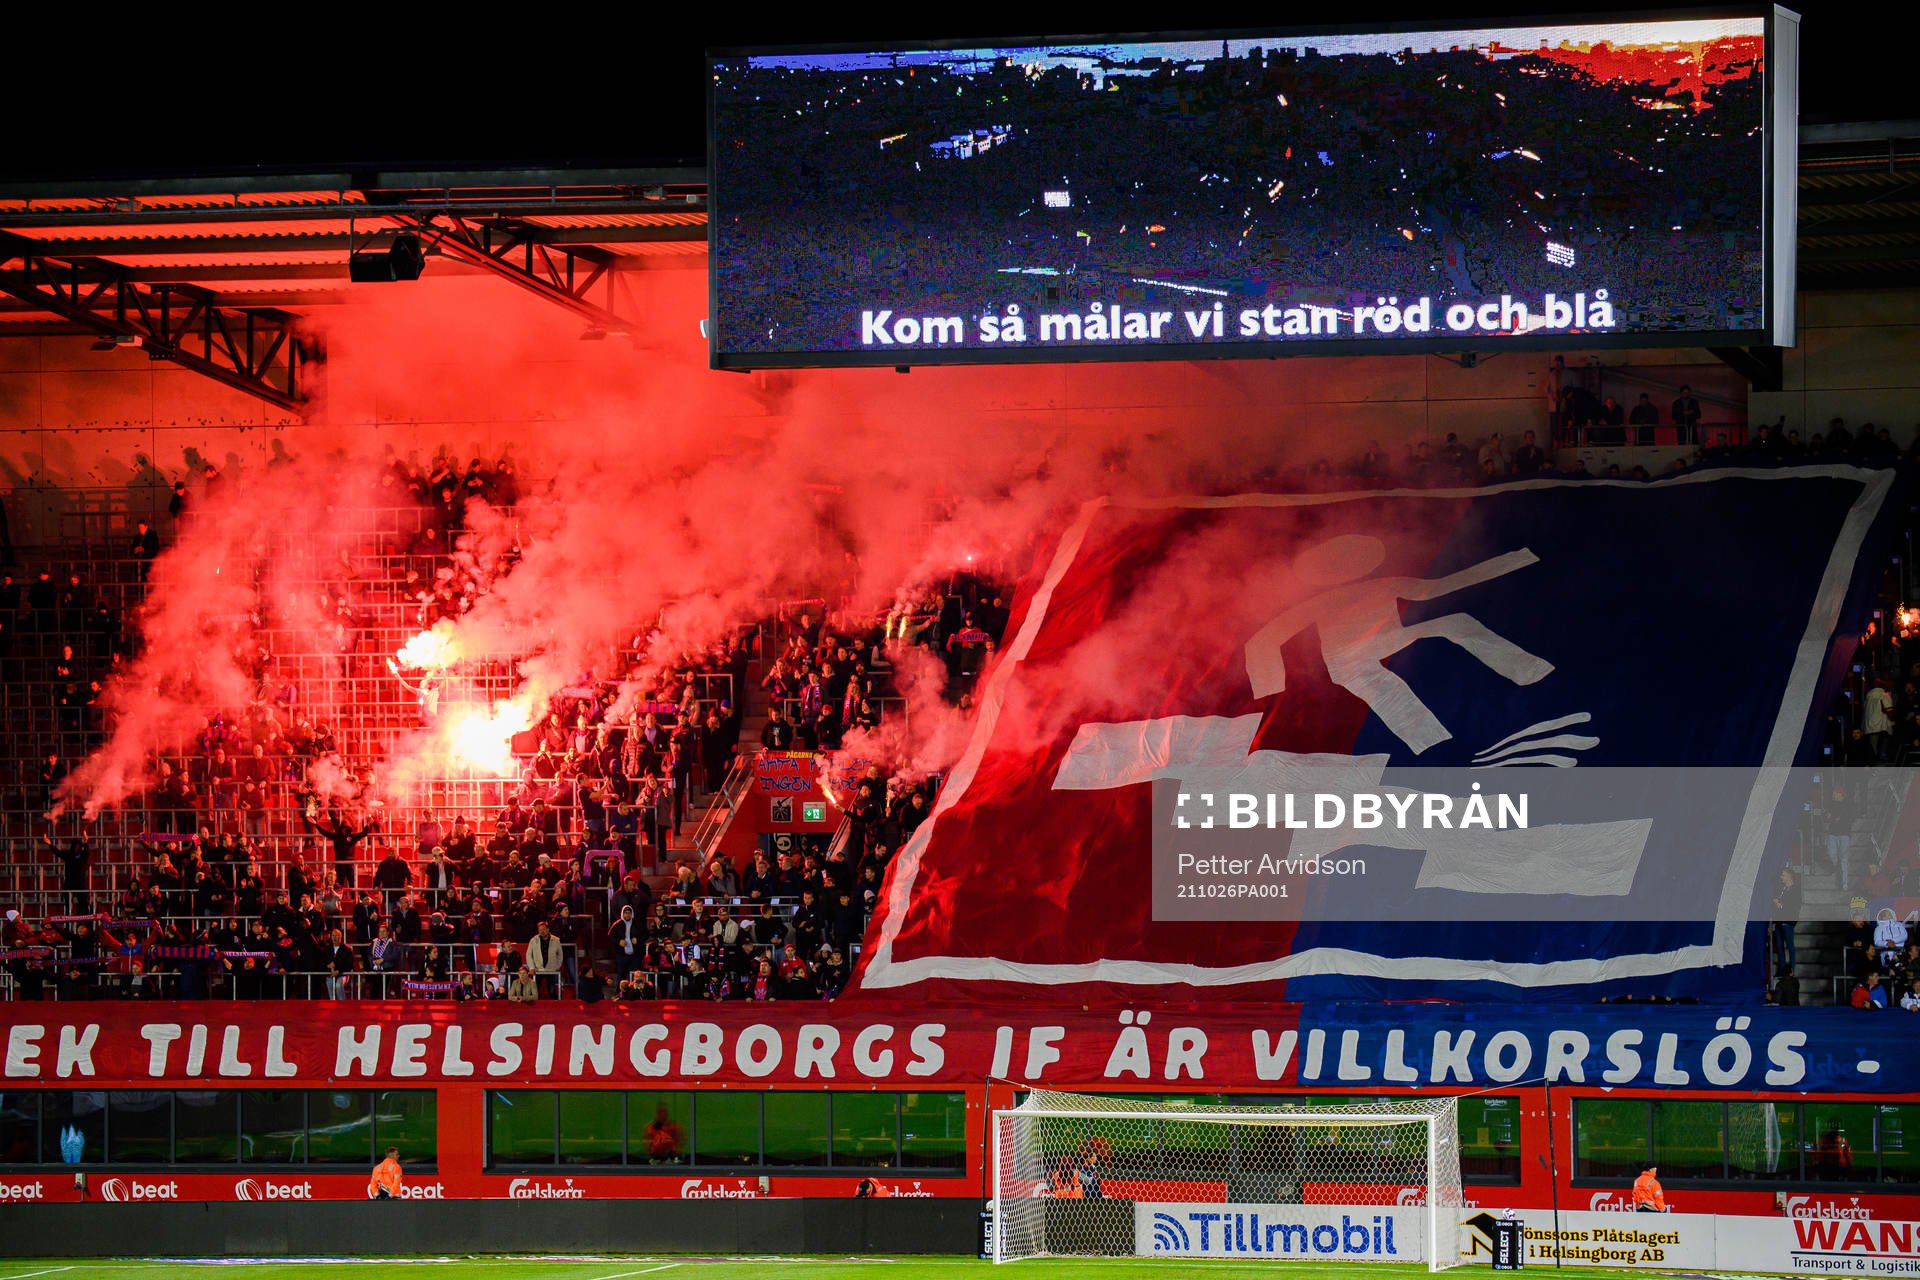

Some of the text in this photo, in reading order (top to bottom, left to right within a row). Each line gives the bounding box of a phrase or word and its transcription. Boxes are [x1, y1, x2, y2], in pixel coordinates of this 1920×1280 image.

[860, 288, 1616, 344] Kom så målar vi stan röd och blå
[760, 776, 812, 792] INGEN
[5, 1024, 100, 1078] EK
[141, 1023, 298, 1077] TILL
[334, 1022, 946, 1077] HELSINGBORGS
[991, 1026, 1065, 1079] IF
[1103, 1009, 1208, 1080] ÄR
[1251, 1015, 1807, 1086] VILLKORSLÖS
[132, 1181, 178, 1198] beat
[266, 1182, 312, 1199] beat
[401, 1182, 445, 1199] beat
[508, 1178, 584, 1198] Carlsberg
[1786, 1196, 1870, 1220] Carlsberg
[1188, 1212, 1398, 1255] Tillmobil
[1524, 1226, 1681, 1247] önssons Plåtslageri
[1793, 1219, 1920, 1253] WAN
[1500, 1230, 1509, 1264] SELECT
[1529, 1244, 1535, 1258] i
[1539, 1245, 1637, 1264] Helsingborg
[1639, 1248, 1665, 1262] AB
[1792, 1256, 1920, 1274] Transport & Logistik
